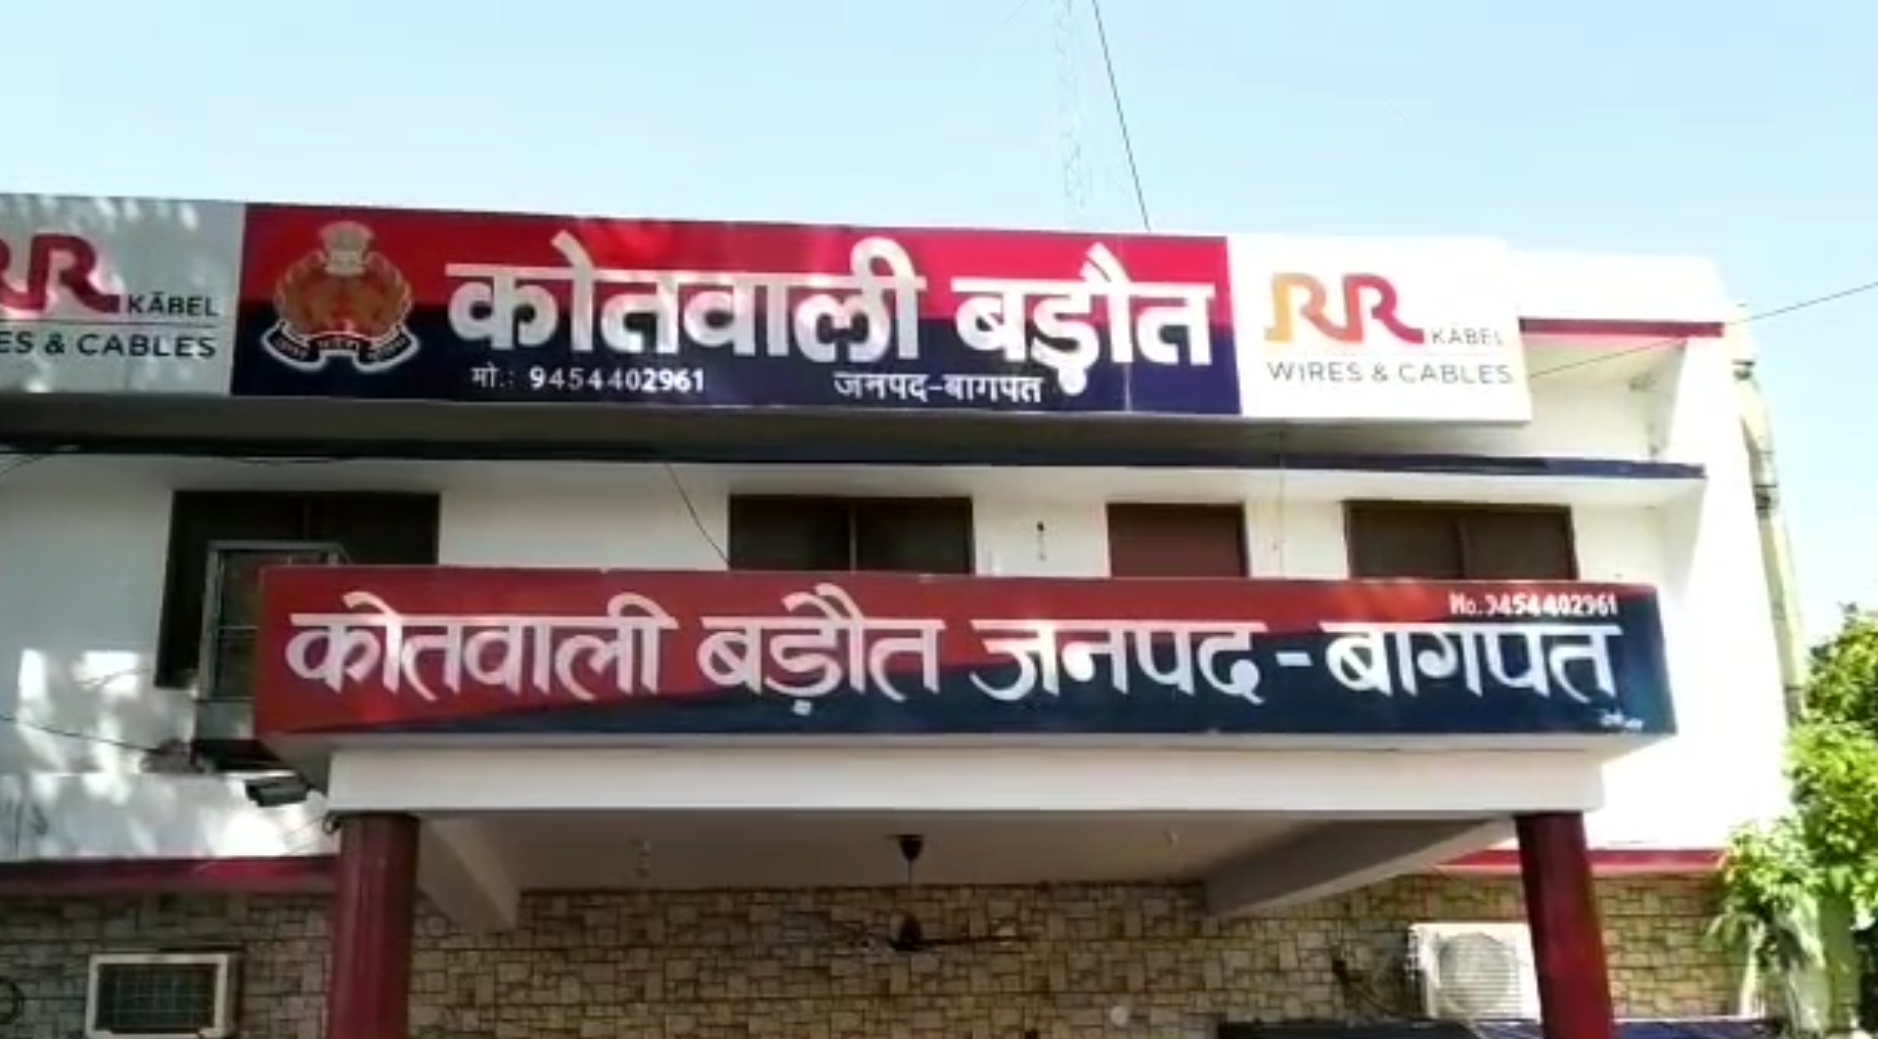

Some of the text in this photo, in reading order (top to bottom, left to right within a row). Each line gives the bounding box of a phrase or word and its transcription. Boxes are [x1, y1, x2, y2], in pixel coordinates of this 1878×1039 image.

[446, 229, 1216, 396] कोतवाली बड़ौत
[1264, 272, 1425, 344] RR
[45, 334, 66, 356] &
[77, 334, 216, 359] CABLES
[529, 365, 704, 393] 9454402961
[1267, 361, 1514, 386] WIRES & CABLES
[285, 591, 679, 701] कोतवाली
[697, 583, 946, 716] बड़ौत
